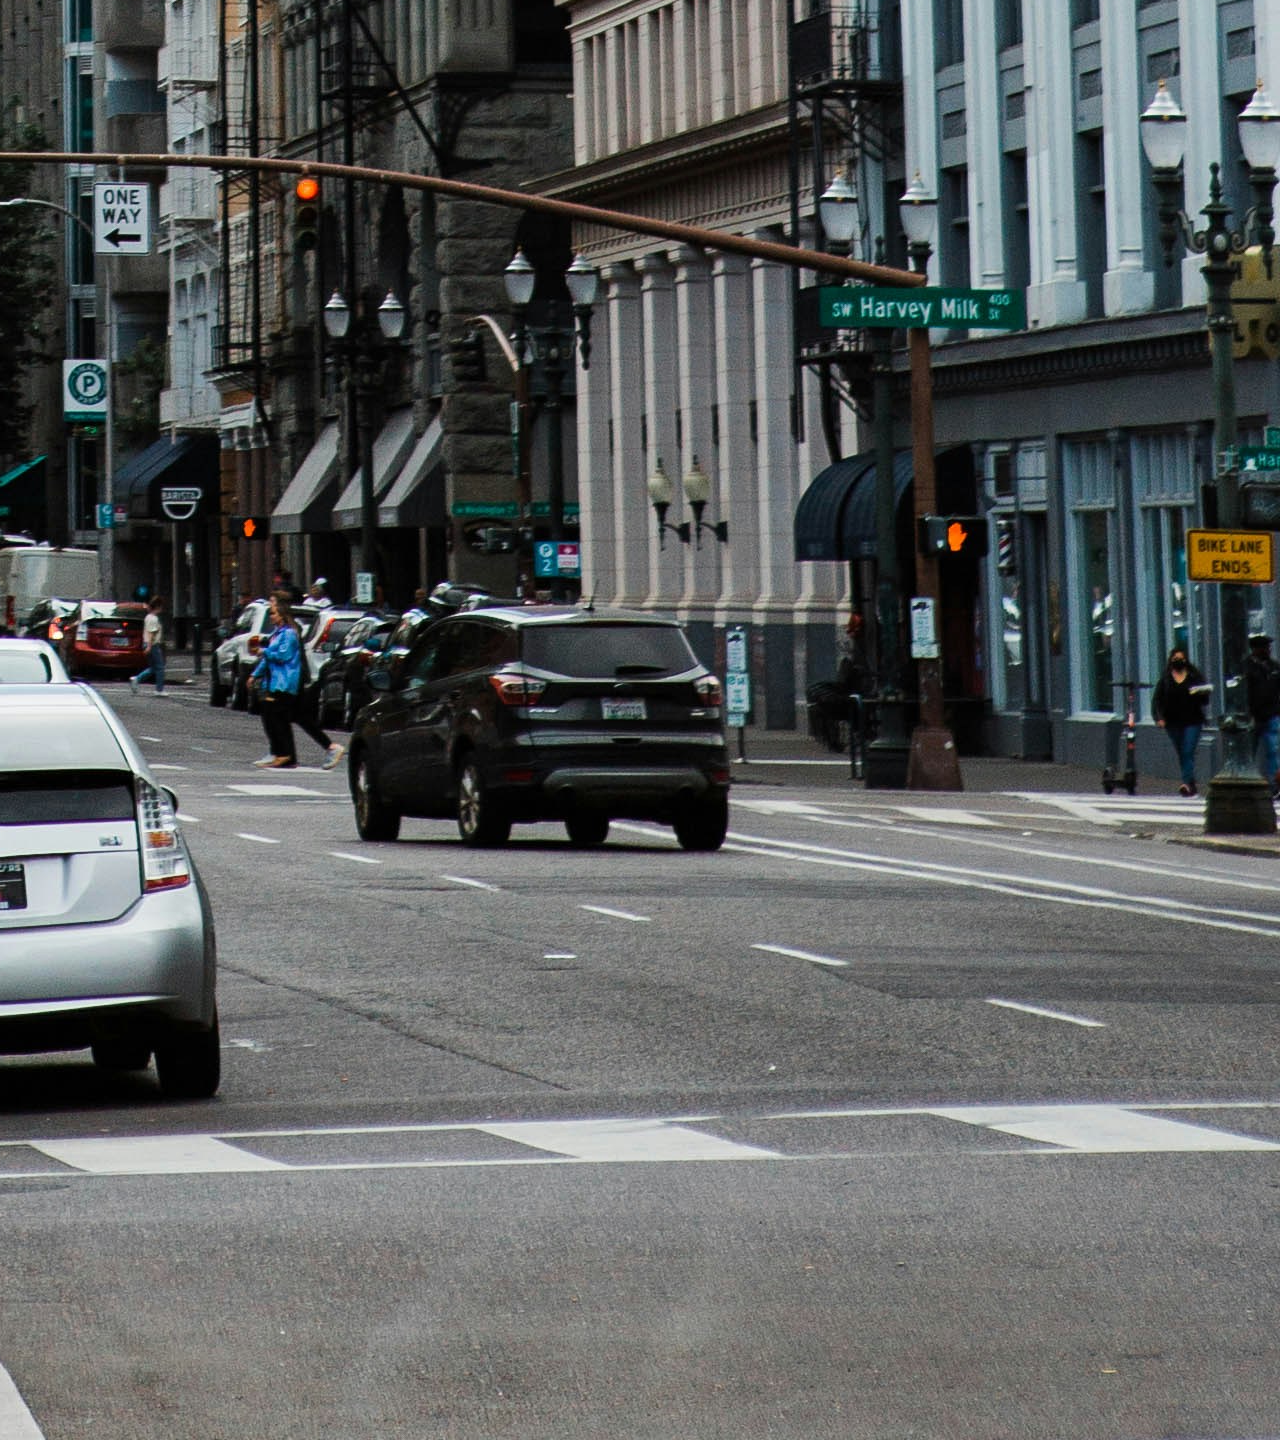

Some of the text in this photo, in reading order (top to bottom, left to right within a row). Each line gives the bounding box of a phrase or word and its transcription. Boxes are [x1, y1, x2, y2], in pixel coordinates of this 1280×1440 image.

[103, 188, 139, 206] ONE
[103, 206, 141, 225] WAY
[831, 302, 852, 318] SW
[860, 296, 932, 325] Harvey
[940, 297, 979, 320] Milk
[1198, 538, 1264, 555] BIKE LANE
[1211, 560, 1251, 575] ENDS
